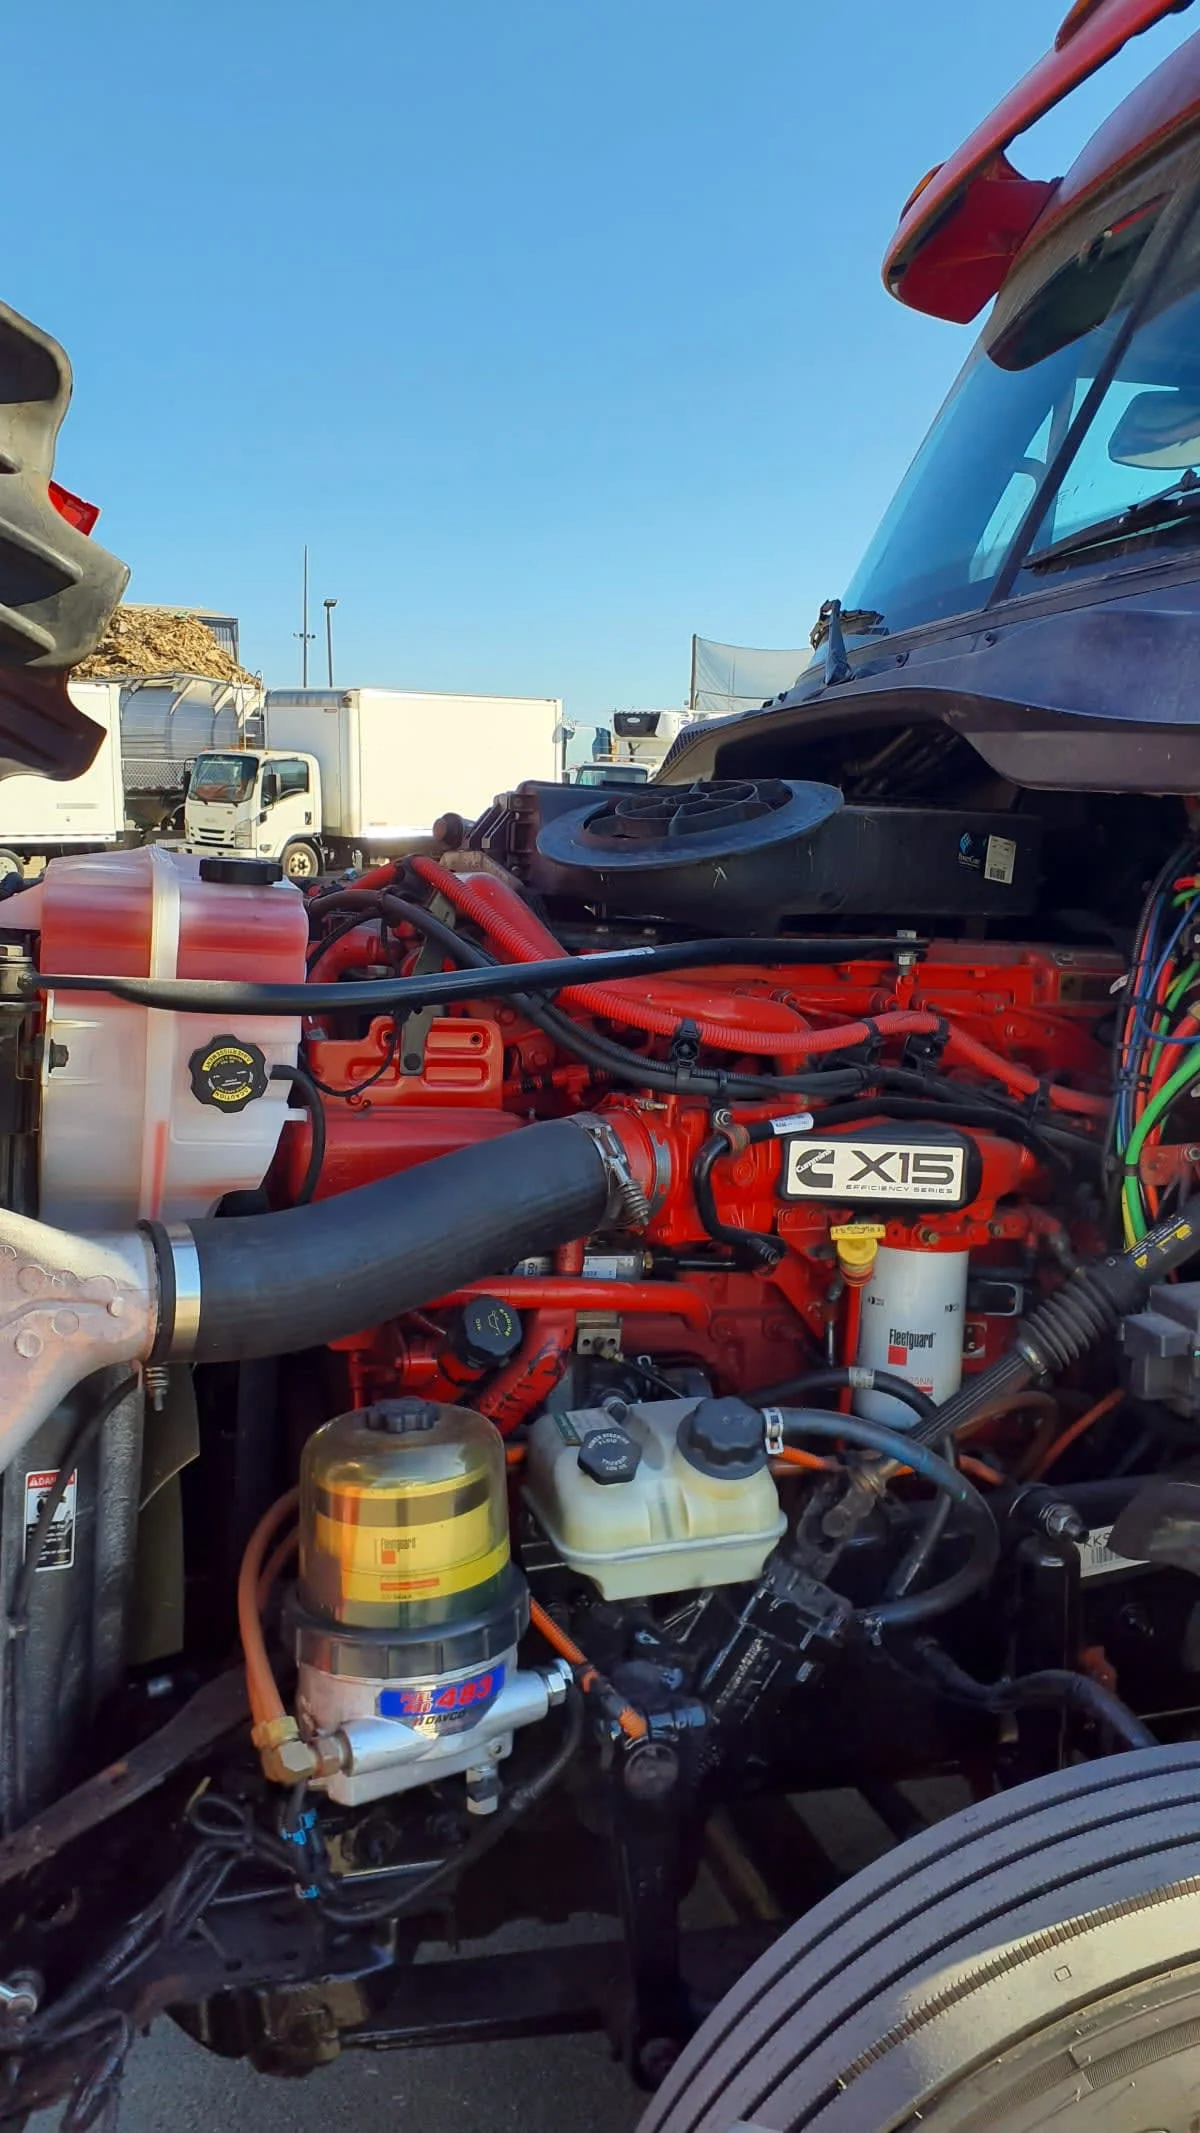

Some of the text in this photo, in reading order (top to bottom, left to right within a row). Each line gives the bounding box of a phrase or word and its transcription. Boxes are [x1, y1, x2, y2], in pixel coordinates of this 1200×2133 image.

[203, 1048, 251, 1069] AVERTISSEMENT
[214, 1089, 246, 1100] CAUTION
[795, 1149, 833, 1173] Cummins
[848, 1150, 955, 1185] X15
[845, 1183, 953, 1194] EFFICIENCY SERIES
[499, 1308, 512, 1337] ENGINE
[889, 1328, 934, 1350] Fleetguard
[381, 1537, 416, 1552] Fleetguard
[435, 1674, 493, 1709] 483
[424, 1711, 466, 1725] DAVCO
